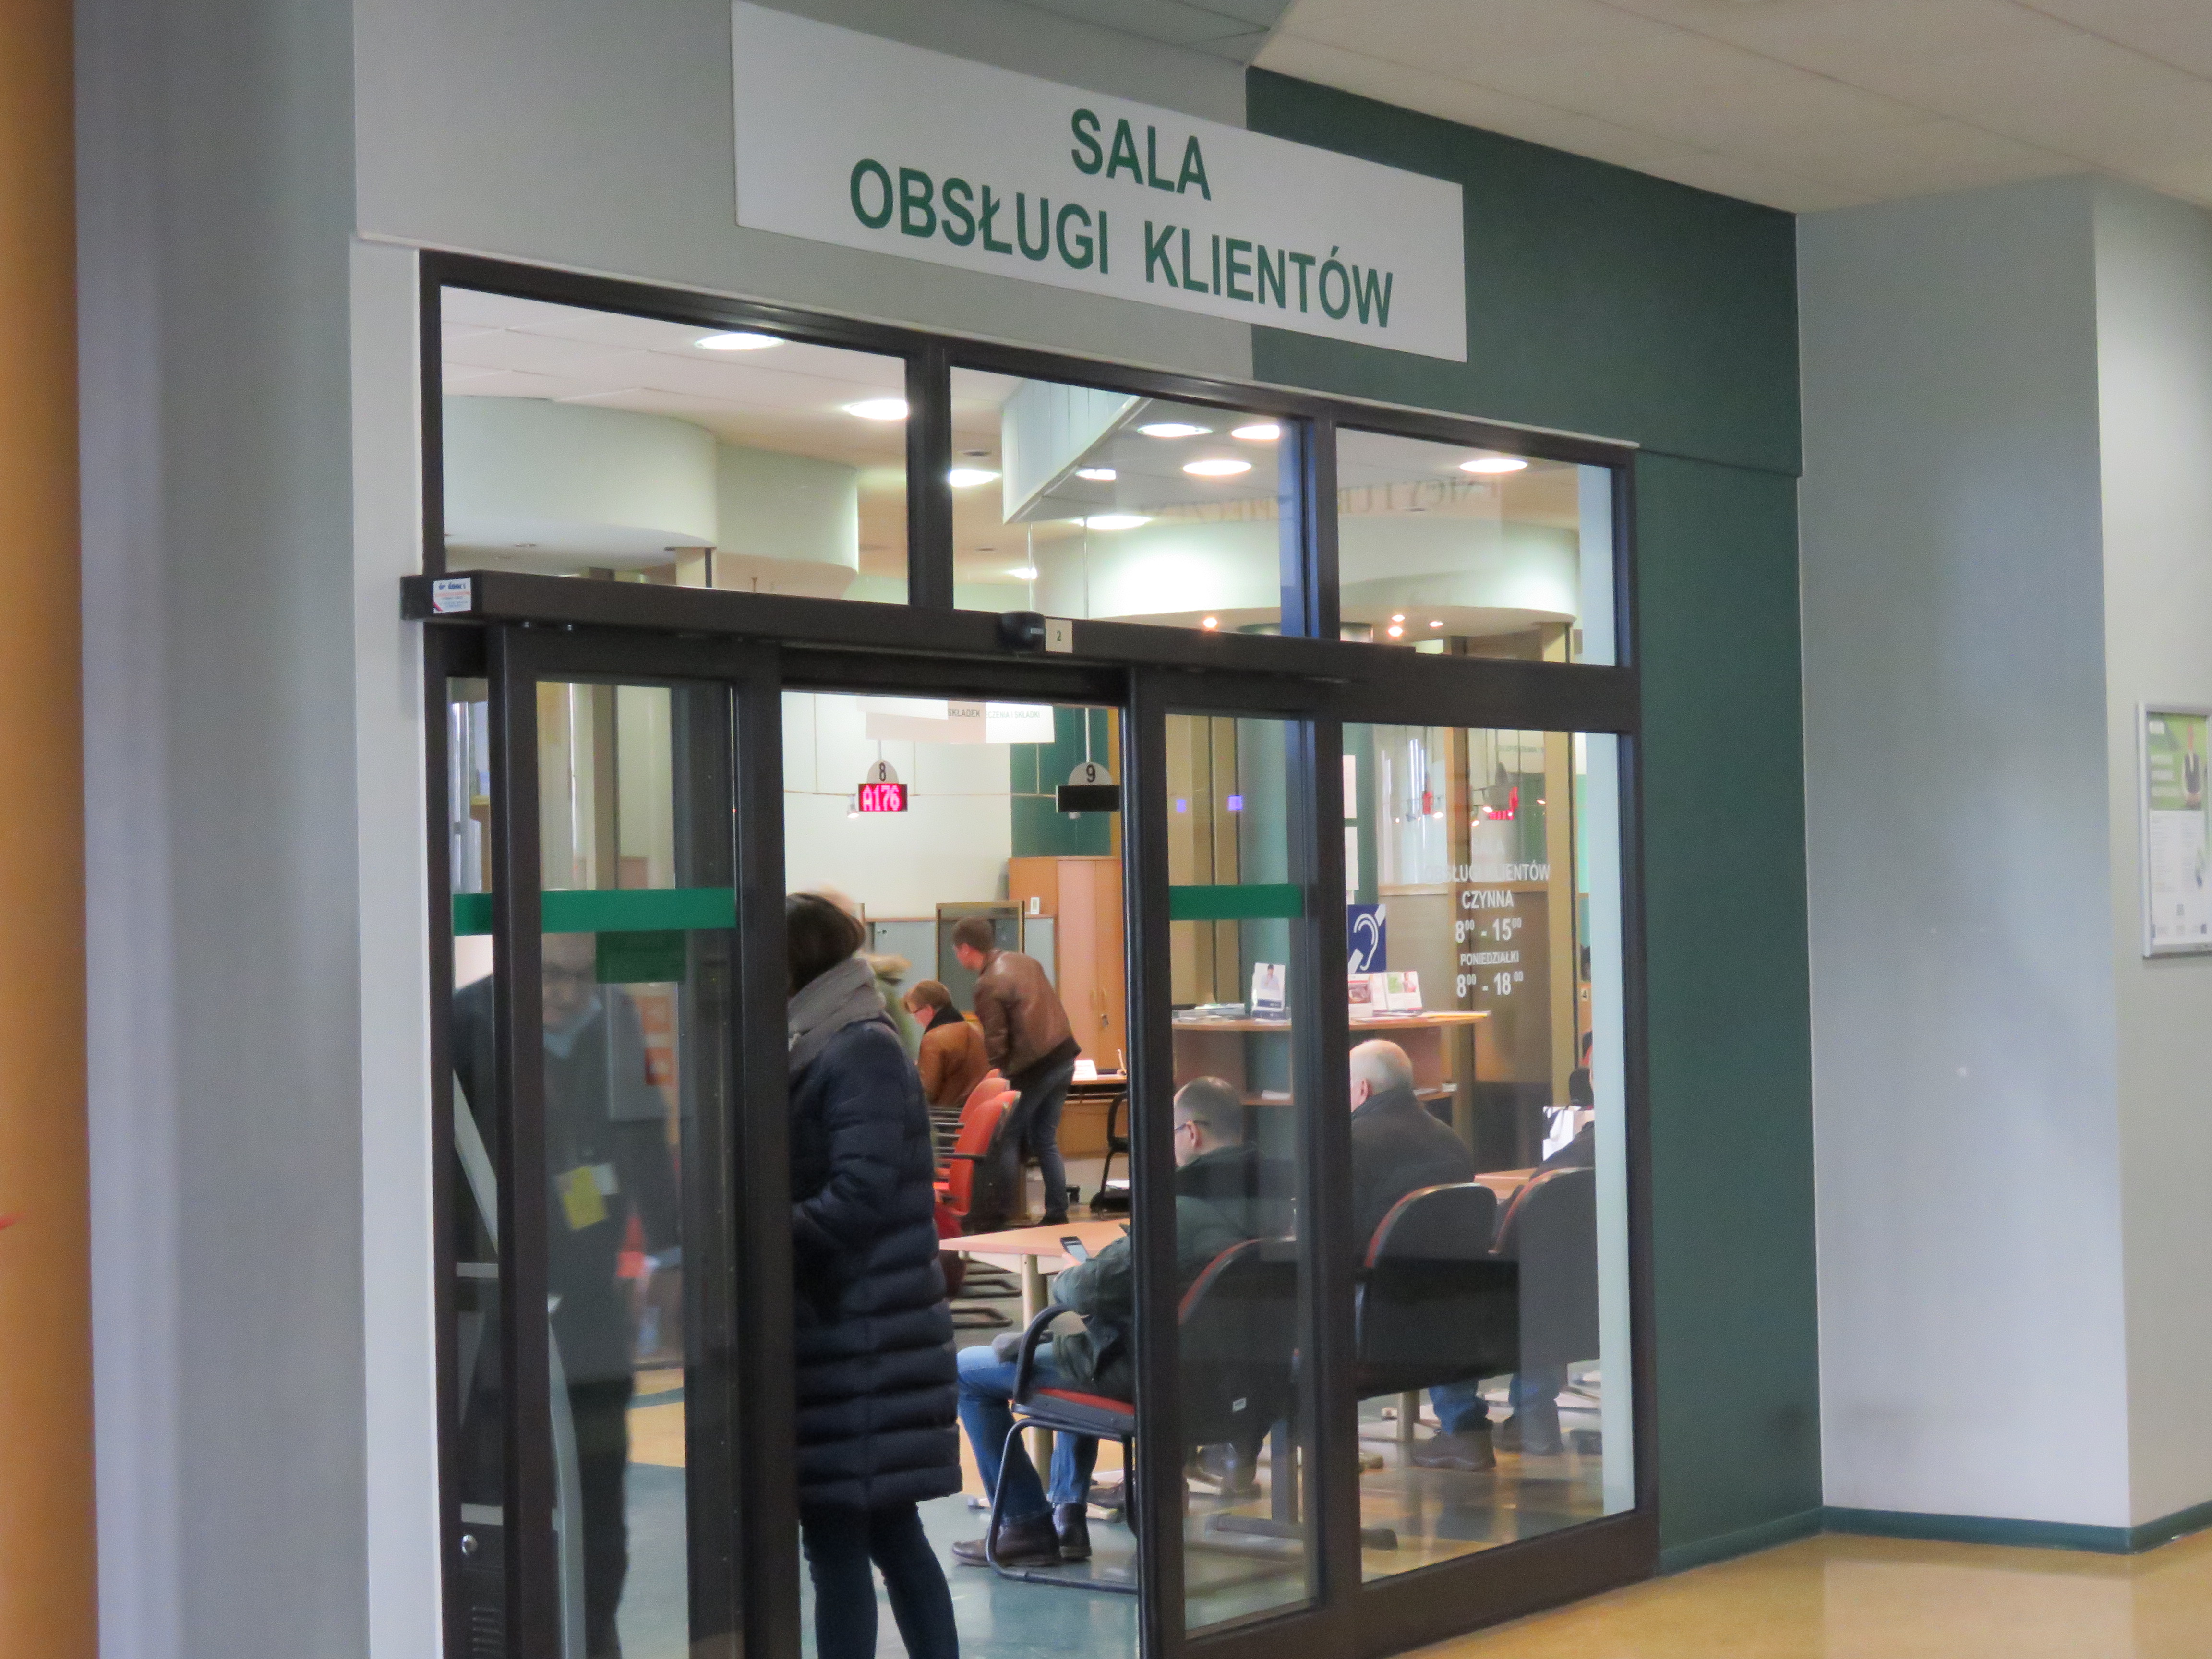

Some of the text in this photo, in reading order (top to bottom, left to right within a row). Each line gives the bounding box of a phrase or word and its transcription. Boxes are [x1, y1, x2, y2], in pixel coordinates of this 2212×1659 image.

[1071, 108, 1211, 201] SALA
[850, 158, 1393, 328] OBSŁUGI KLIENTÓW
[1056, 629, 1062, 642] 2
[879, 762, 886, 782] 8
[1086, 764, 1096, 782] 9
[862, 784, 901, 811] A176
[1462, 890, 1514, 909] CZYNNA
